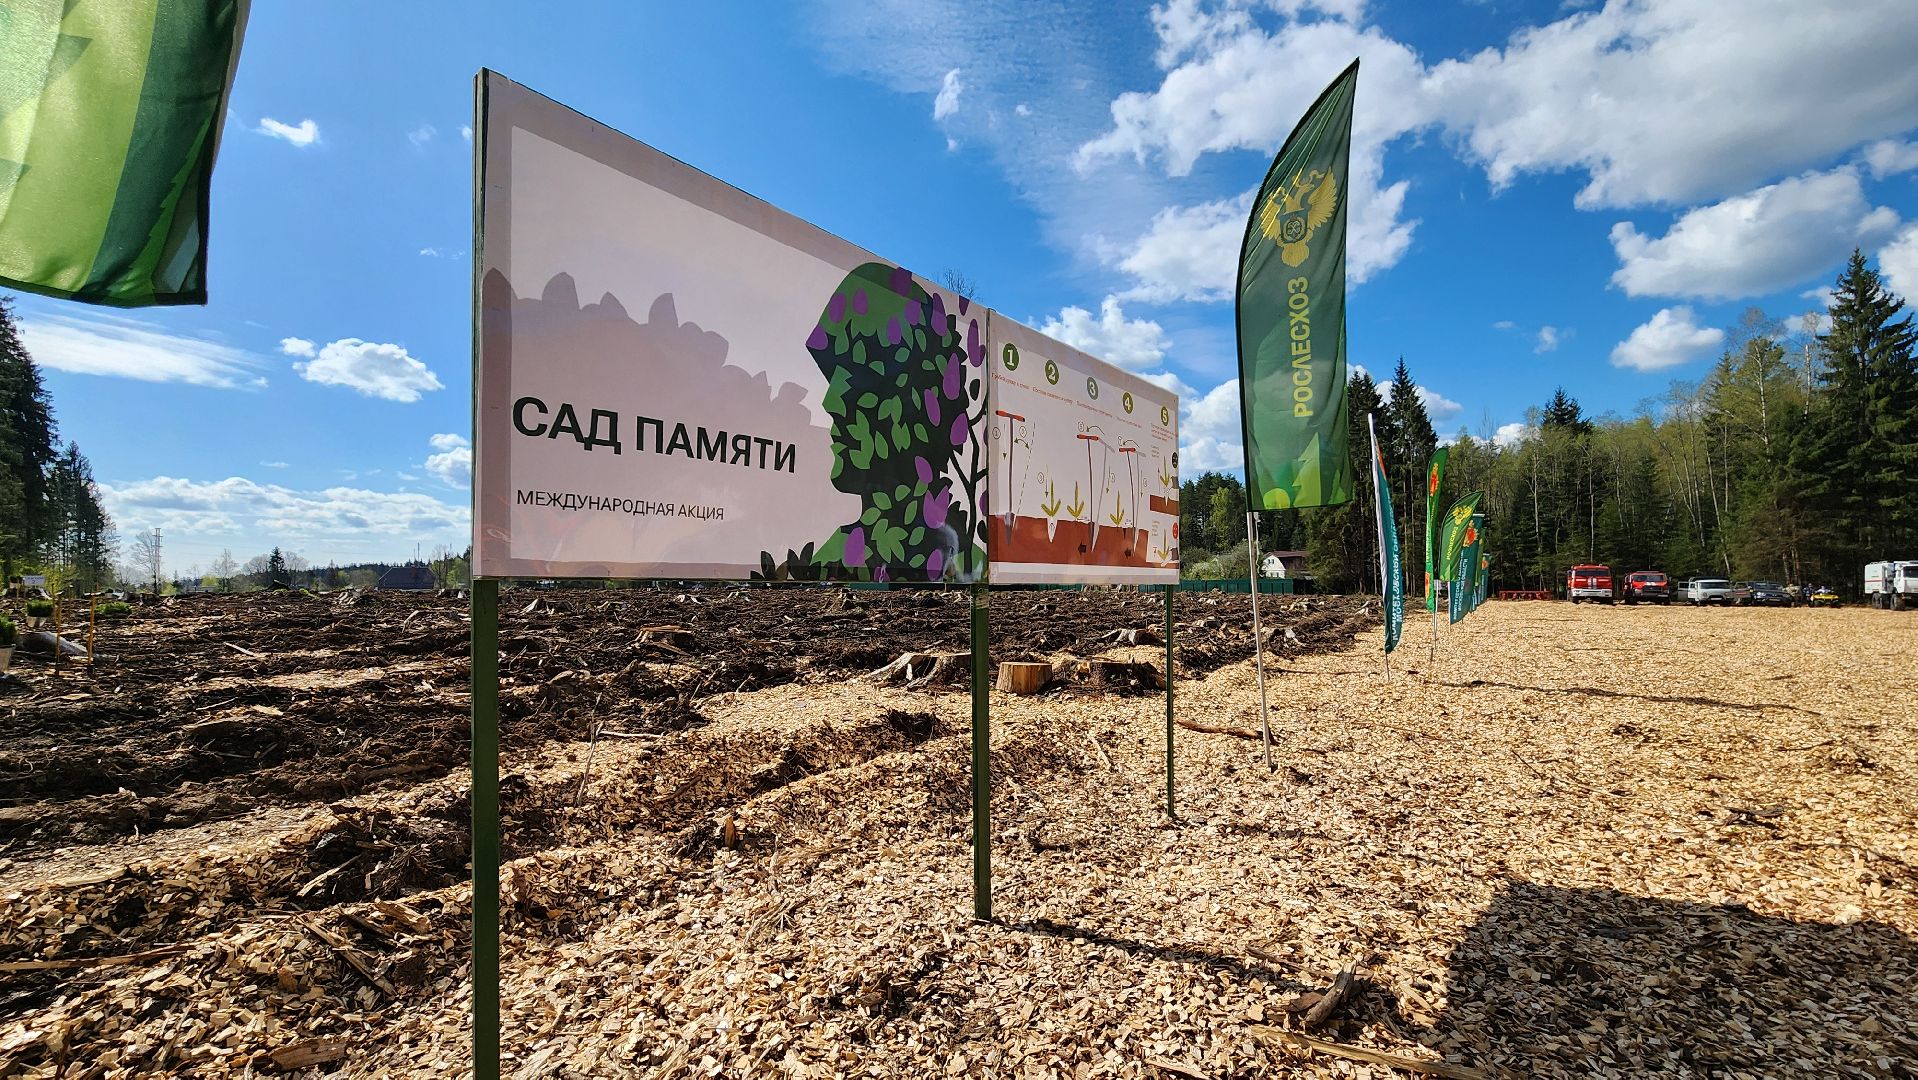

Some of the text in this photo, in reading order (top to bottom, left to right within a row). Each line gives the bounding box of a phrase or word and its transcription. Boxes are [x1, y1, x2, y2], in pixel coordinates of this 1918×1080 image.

[1288, 276, 1314, 418] РОСЛЕСХОЗ
[1007, 349, 1015, 367] 1
[1047, 363, 1057, 382] 2
[1089, 381, 1096, 397] 3
[1124, 396, 1131, 411] 4
[1161, 409, 1168, 423] 5
[512, 396, 796, 473] САД ПАМЯТИ
[516, 489, 724, 521] МЕЖДУНАРОДНАЯ АКЦИЯ
